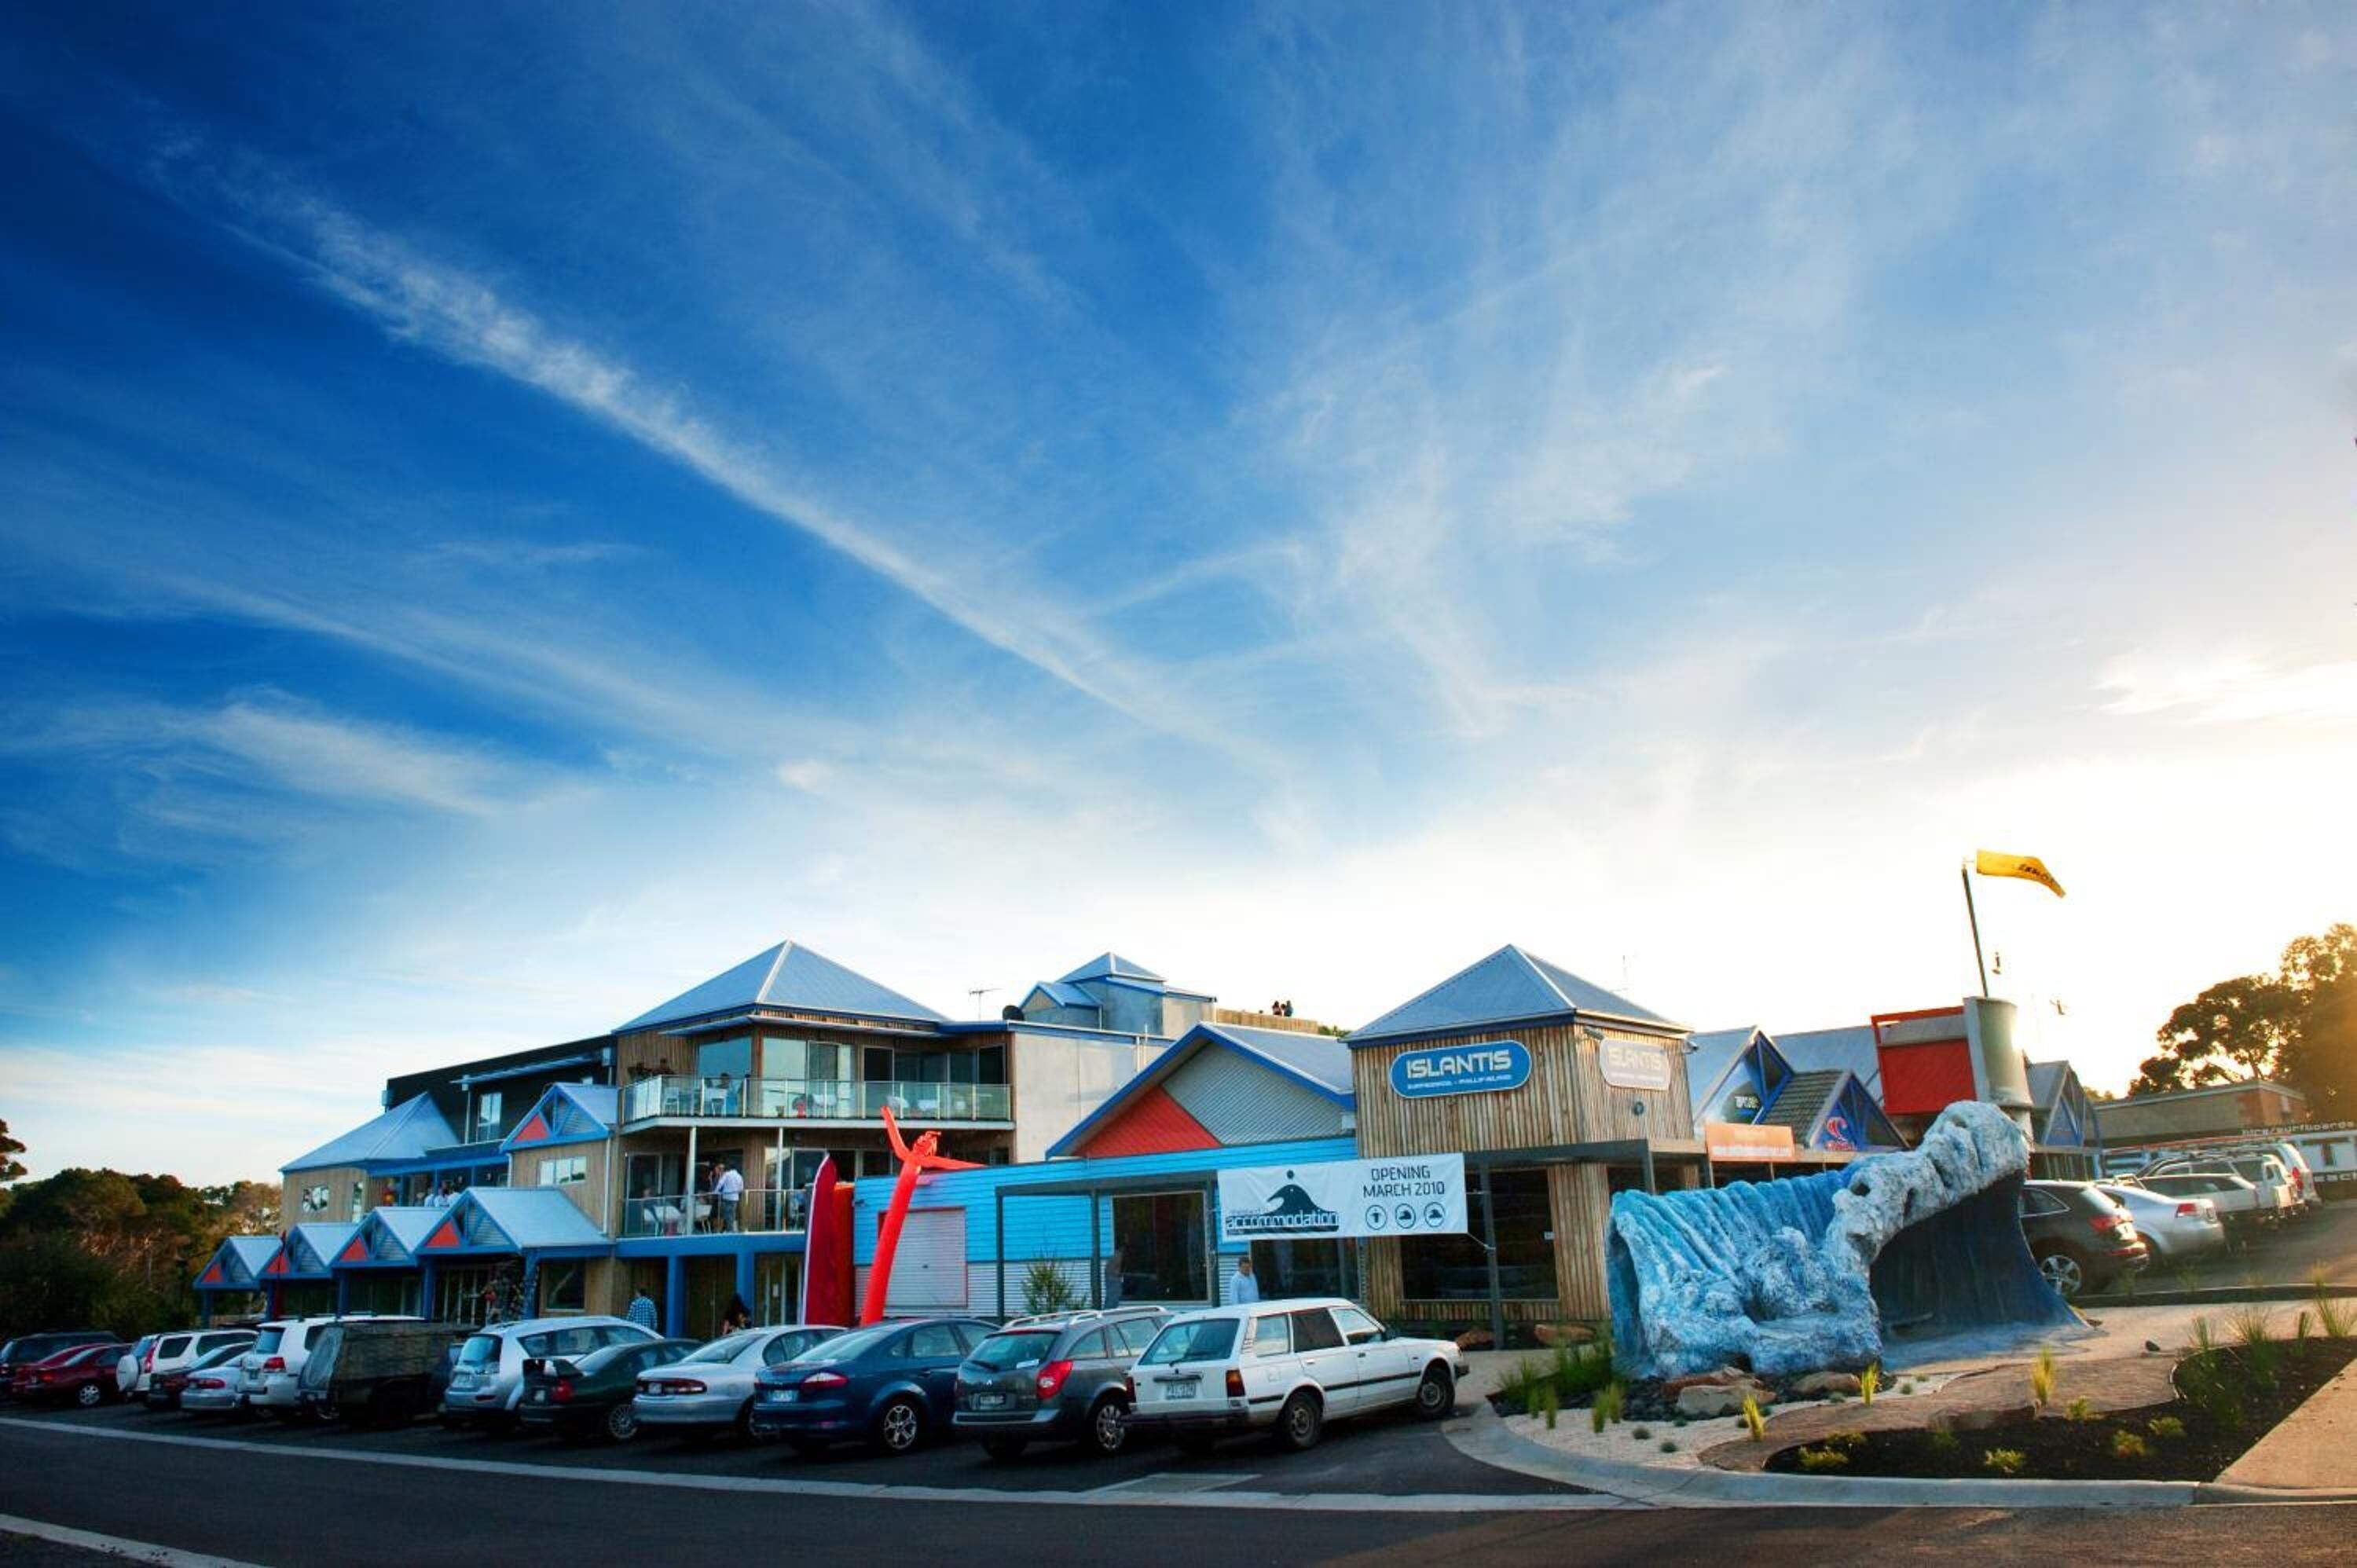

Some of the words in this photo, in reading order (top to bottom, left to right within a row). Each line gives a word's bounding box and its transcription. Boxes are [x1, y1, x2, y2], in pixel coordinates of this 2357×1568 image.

[1406, 1050, 1512, 1079] ISLANTIS
[1370, 1165, 1431, 1181] OPENING
[1363, 1183, 1412, 1198] MARCH
[1414, 1181, 1445, 1196] 2010
[1226, 1209, 1339, 1229] accommodation
